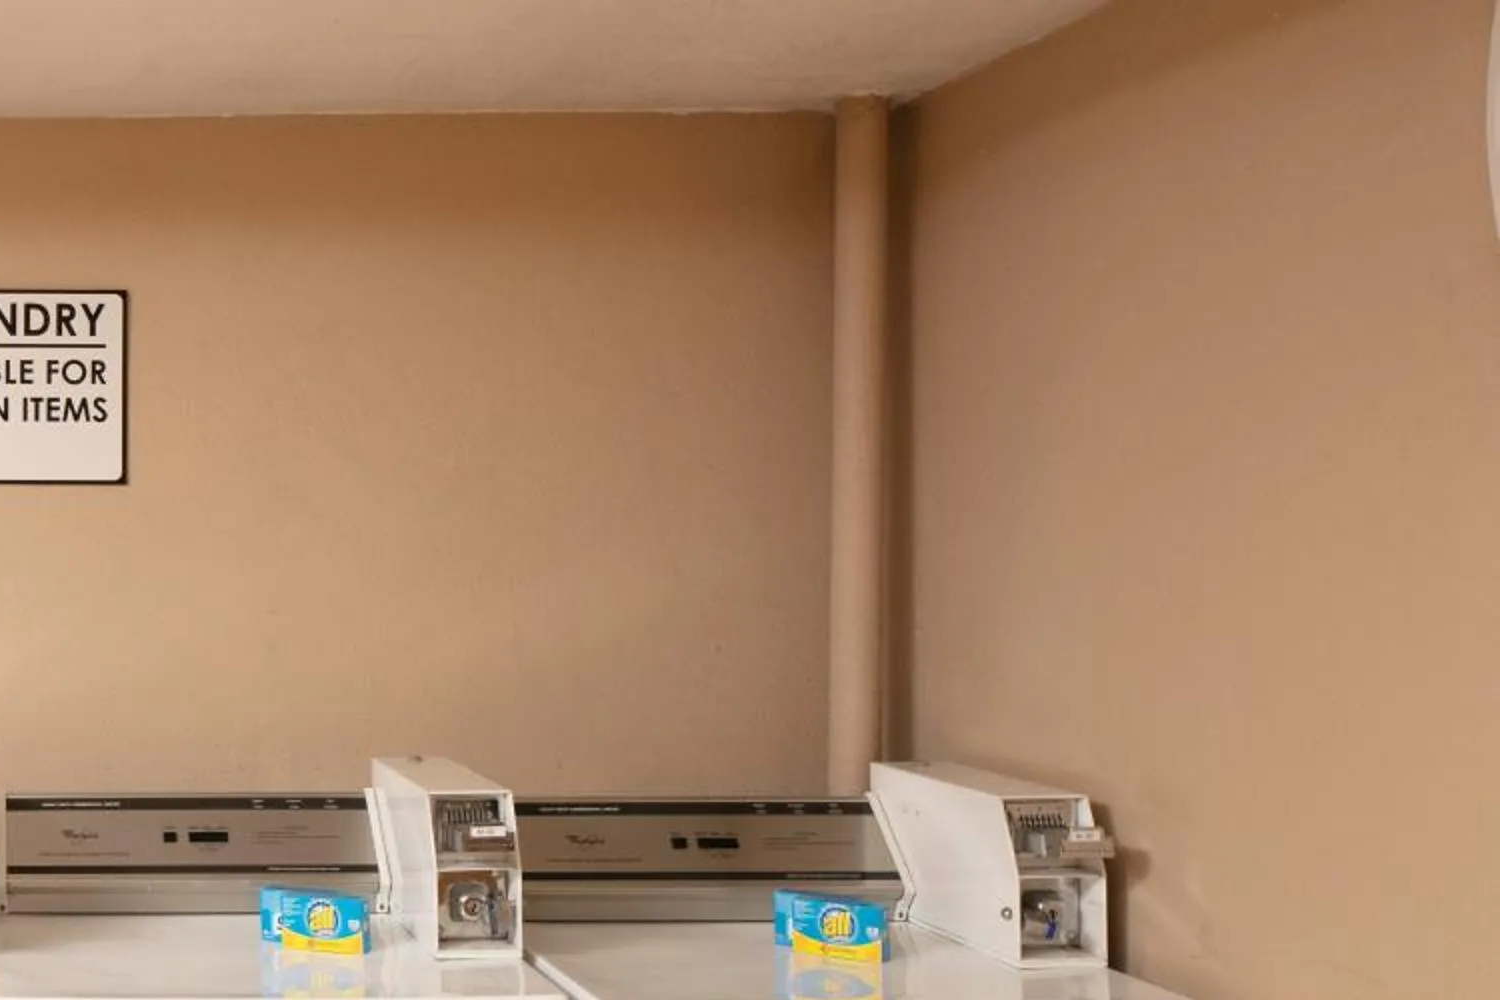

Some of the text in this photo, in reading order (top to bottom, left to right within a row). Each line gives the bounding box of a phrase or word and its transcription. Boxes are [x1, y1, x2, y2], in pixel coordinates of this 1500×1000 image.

[46, 359, 106, 385] FOR
[23, 397, 108, 422] ITEMS
[822, 911, 850, 938] all
